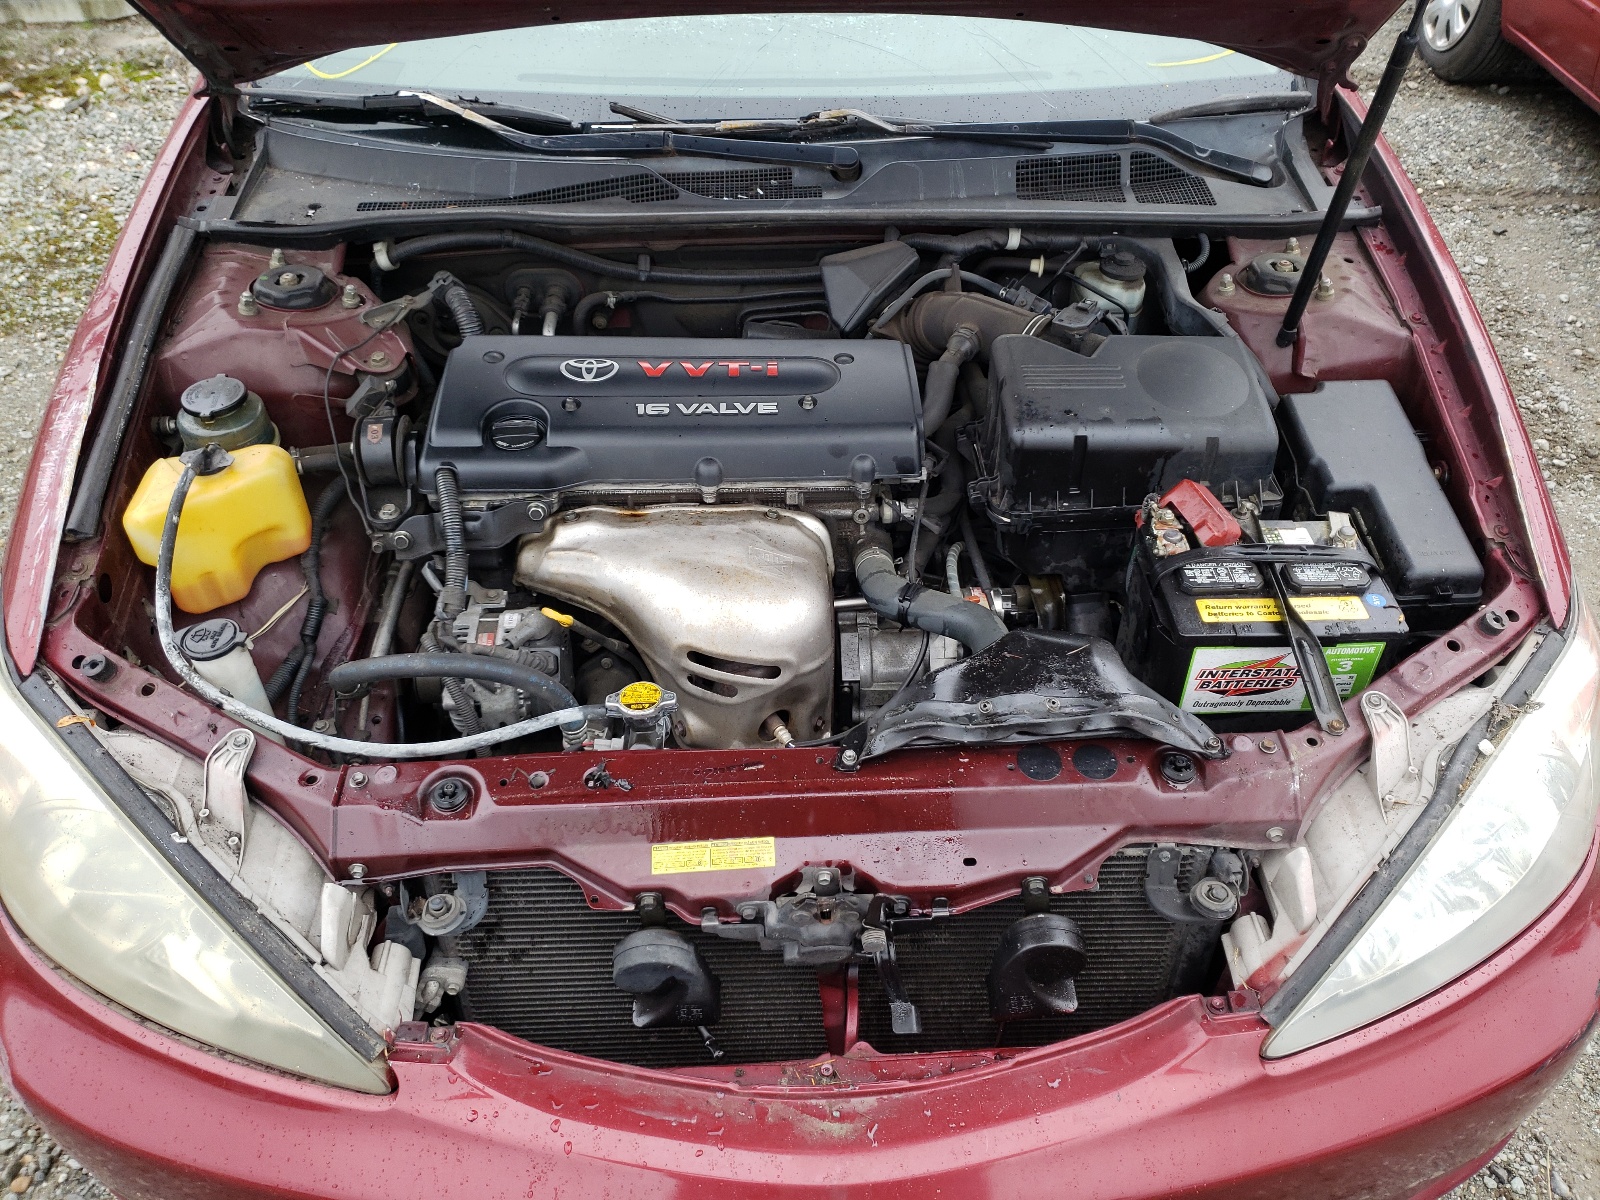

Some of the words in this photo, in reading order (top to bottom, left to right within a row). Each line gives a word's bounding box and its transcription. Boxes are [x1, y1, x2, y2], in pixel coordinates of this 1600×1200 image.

[637, 360, 779, 377] VVT-i
[635, 403, 670, 415] 16
[676, 402, 779, 415] VALVE
[1326, 646, 1377, 655] AUTOMOTIVE
[1337, 660, 1353, 672] 3
[1199, 667, 1300, 679] INTERSTATE
[1199, 679, 1293, 689] BATTERIES
[1192, 700, 1245, 708] Outrageously
